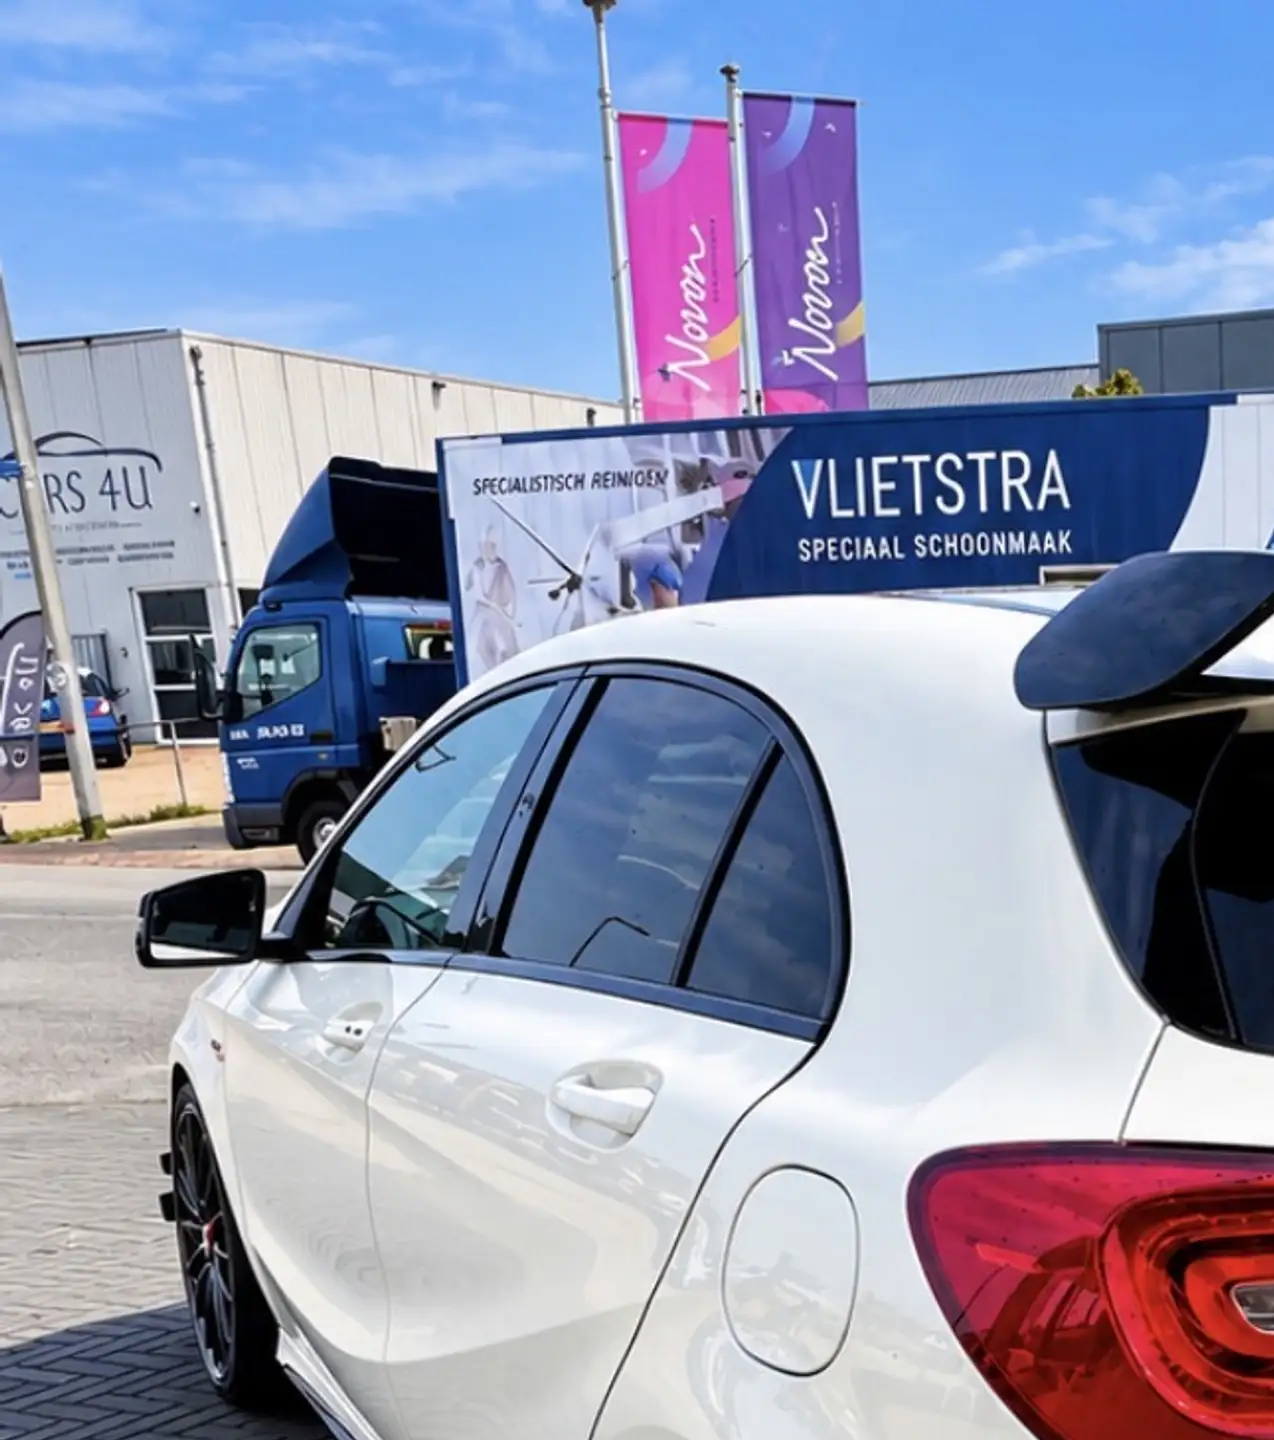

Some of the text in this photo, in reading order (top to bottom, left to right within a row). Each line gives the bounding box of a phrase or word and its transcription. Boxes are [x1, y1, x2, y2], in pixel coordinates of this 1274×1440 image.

[99, 465, 153, 512] 4U
[791, 449, 1072, 520] VLIETSTRA
[798, 530, 1073, 562] SPECIAAL SCHOONMAAK
